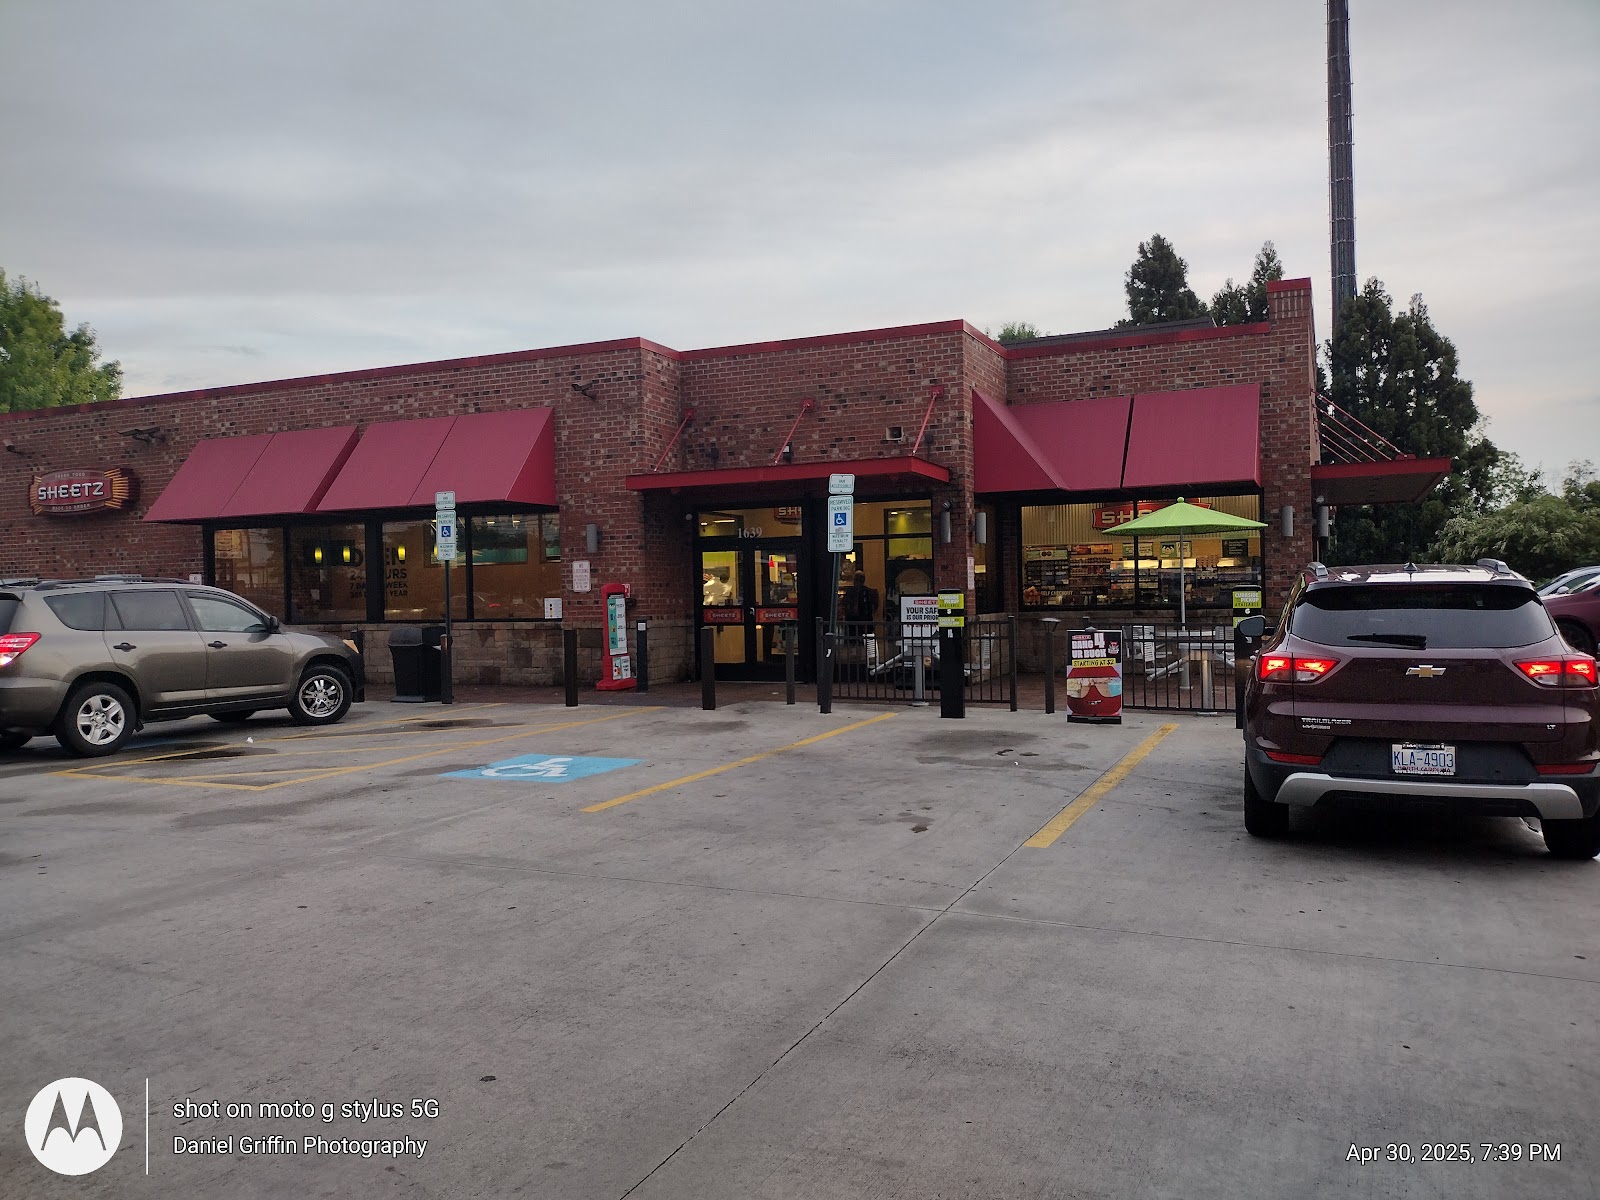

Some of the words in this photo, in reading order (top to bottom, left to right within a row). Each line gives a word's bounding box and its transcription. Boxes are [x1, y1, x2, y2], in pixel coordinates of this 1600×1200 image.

[38, 482, 104, 500] SHEETZ
[737, 527, 763, 539] 1639
[906, 606, 923, 614] YOUR
[925, 606, 938, 614] SAF
[1071, 640, 1094, 649] BANG
[1094, 633, 1105, 648] 4
[1071, 650, 1083, 658] UR
[1083, 649, 1106, 658] BUCK
[1394, 751, 1454, 767] KLA-4903
